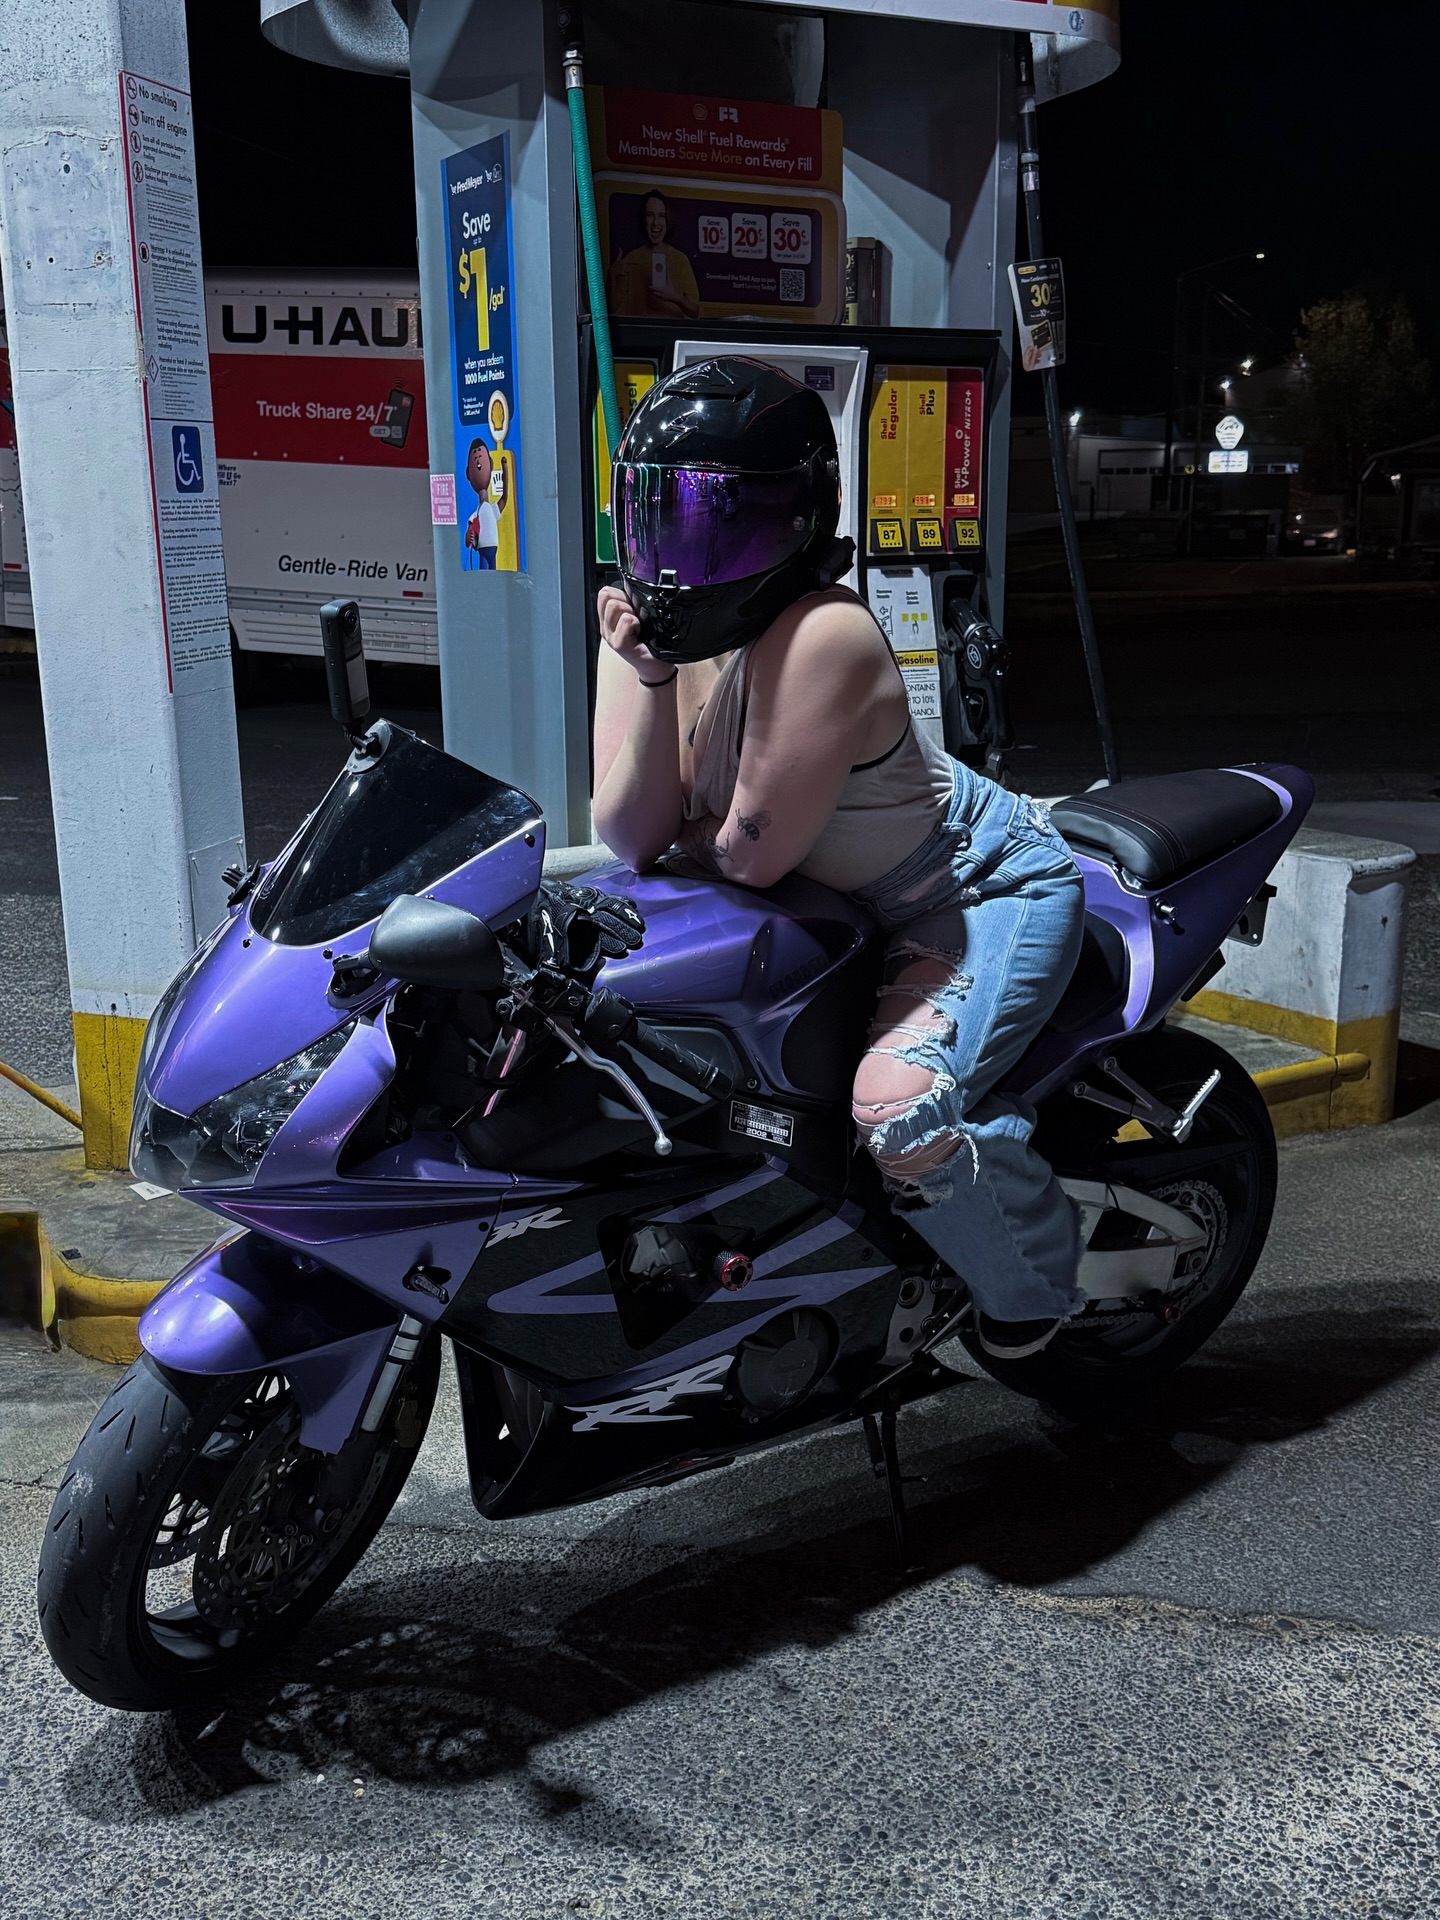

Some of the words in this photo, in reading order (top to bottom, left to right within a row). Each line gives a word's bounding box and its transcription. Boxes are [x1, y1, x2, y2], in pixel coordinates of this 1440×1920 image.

[139, 84, 149, 99] No
[151, 92, 177, 112] smoking
[140, 110, 155, 126] Turn
[156, 116, 165, 129] off
[167, 123, 187, 137] engine
[642, 124, 672, 141] New
[709, 132, 733, 147] Fuel
[618, 140, 676, 159] Members
[678, 146, 708, 162] Save
[711, 149, 742, 165] More
[745, 156, 760, 166] on
[763, 155, 795, 174] Every
[797, 157, 812, 171] Fill
[462, 211, 491, 239] Save
[782, 218, 800, 227] Save
[222, 305, 423, 349] U-HAU
[464, 357, 477, 370] when
[477, 360, 486, 372] you
[486, 353, 504, 367] redeem
[464, 373, 477, 385] 1000
[478, 370, 488, 383] Fuel
[489, 369, 505, 382] Points
[256, 400, 301, 418] Truck
[305, 402, 352, 420] Share
[926, 389, 935, 415] Plus
[888, 388, 899, 440] Regular
[961, 434, 971, 489] V-Power
[883, 530, 896, 540] 87
[922, 529, 936, 539] 89
[961, 529, 975, 538] 92
[278, 554, 388, 579] Gentle-Ride
[396, 563, 429, 582] Van
[897, 654, 935, 665] Gasoline
[906, 683, 935, 692] ONTAINS
[912, 696, 920, 704] TO
[922, 695, 935, 704] 10%
[911, 708, 935, 716] HANOL
[746, 1127, 768, 1138] 2002
